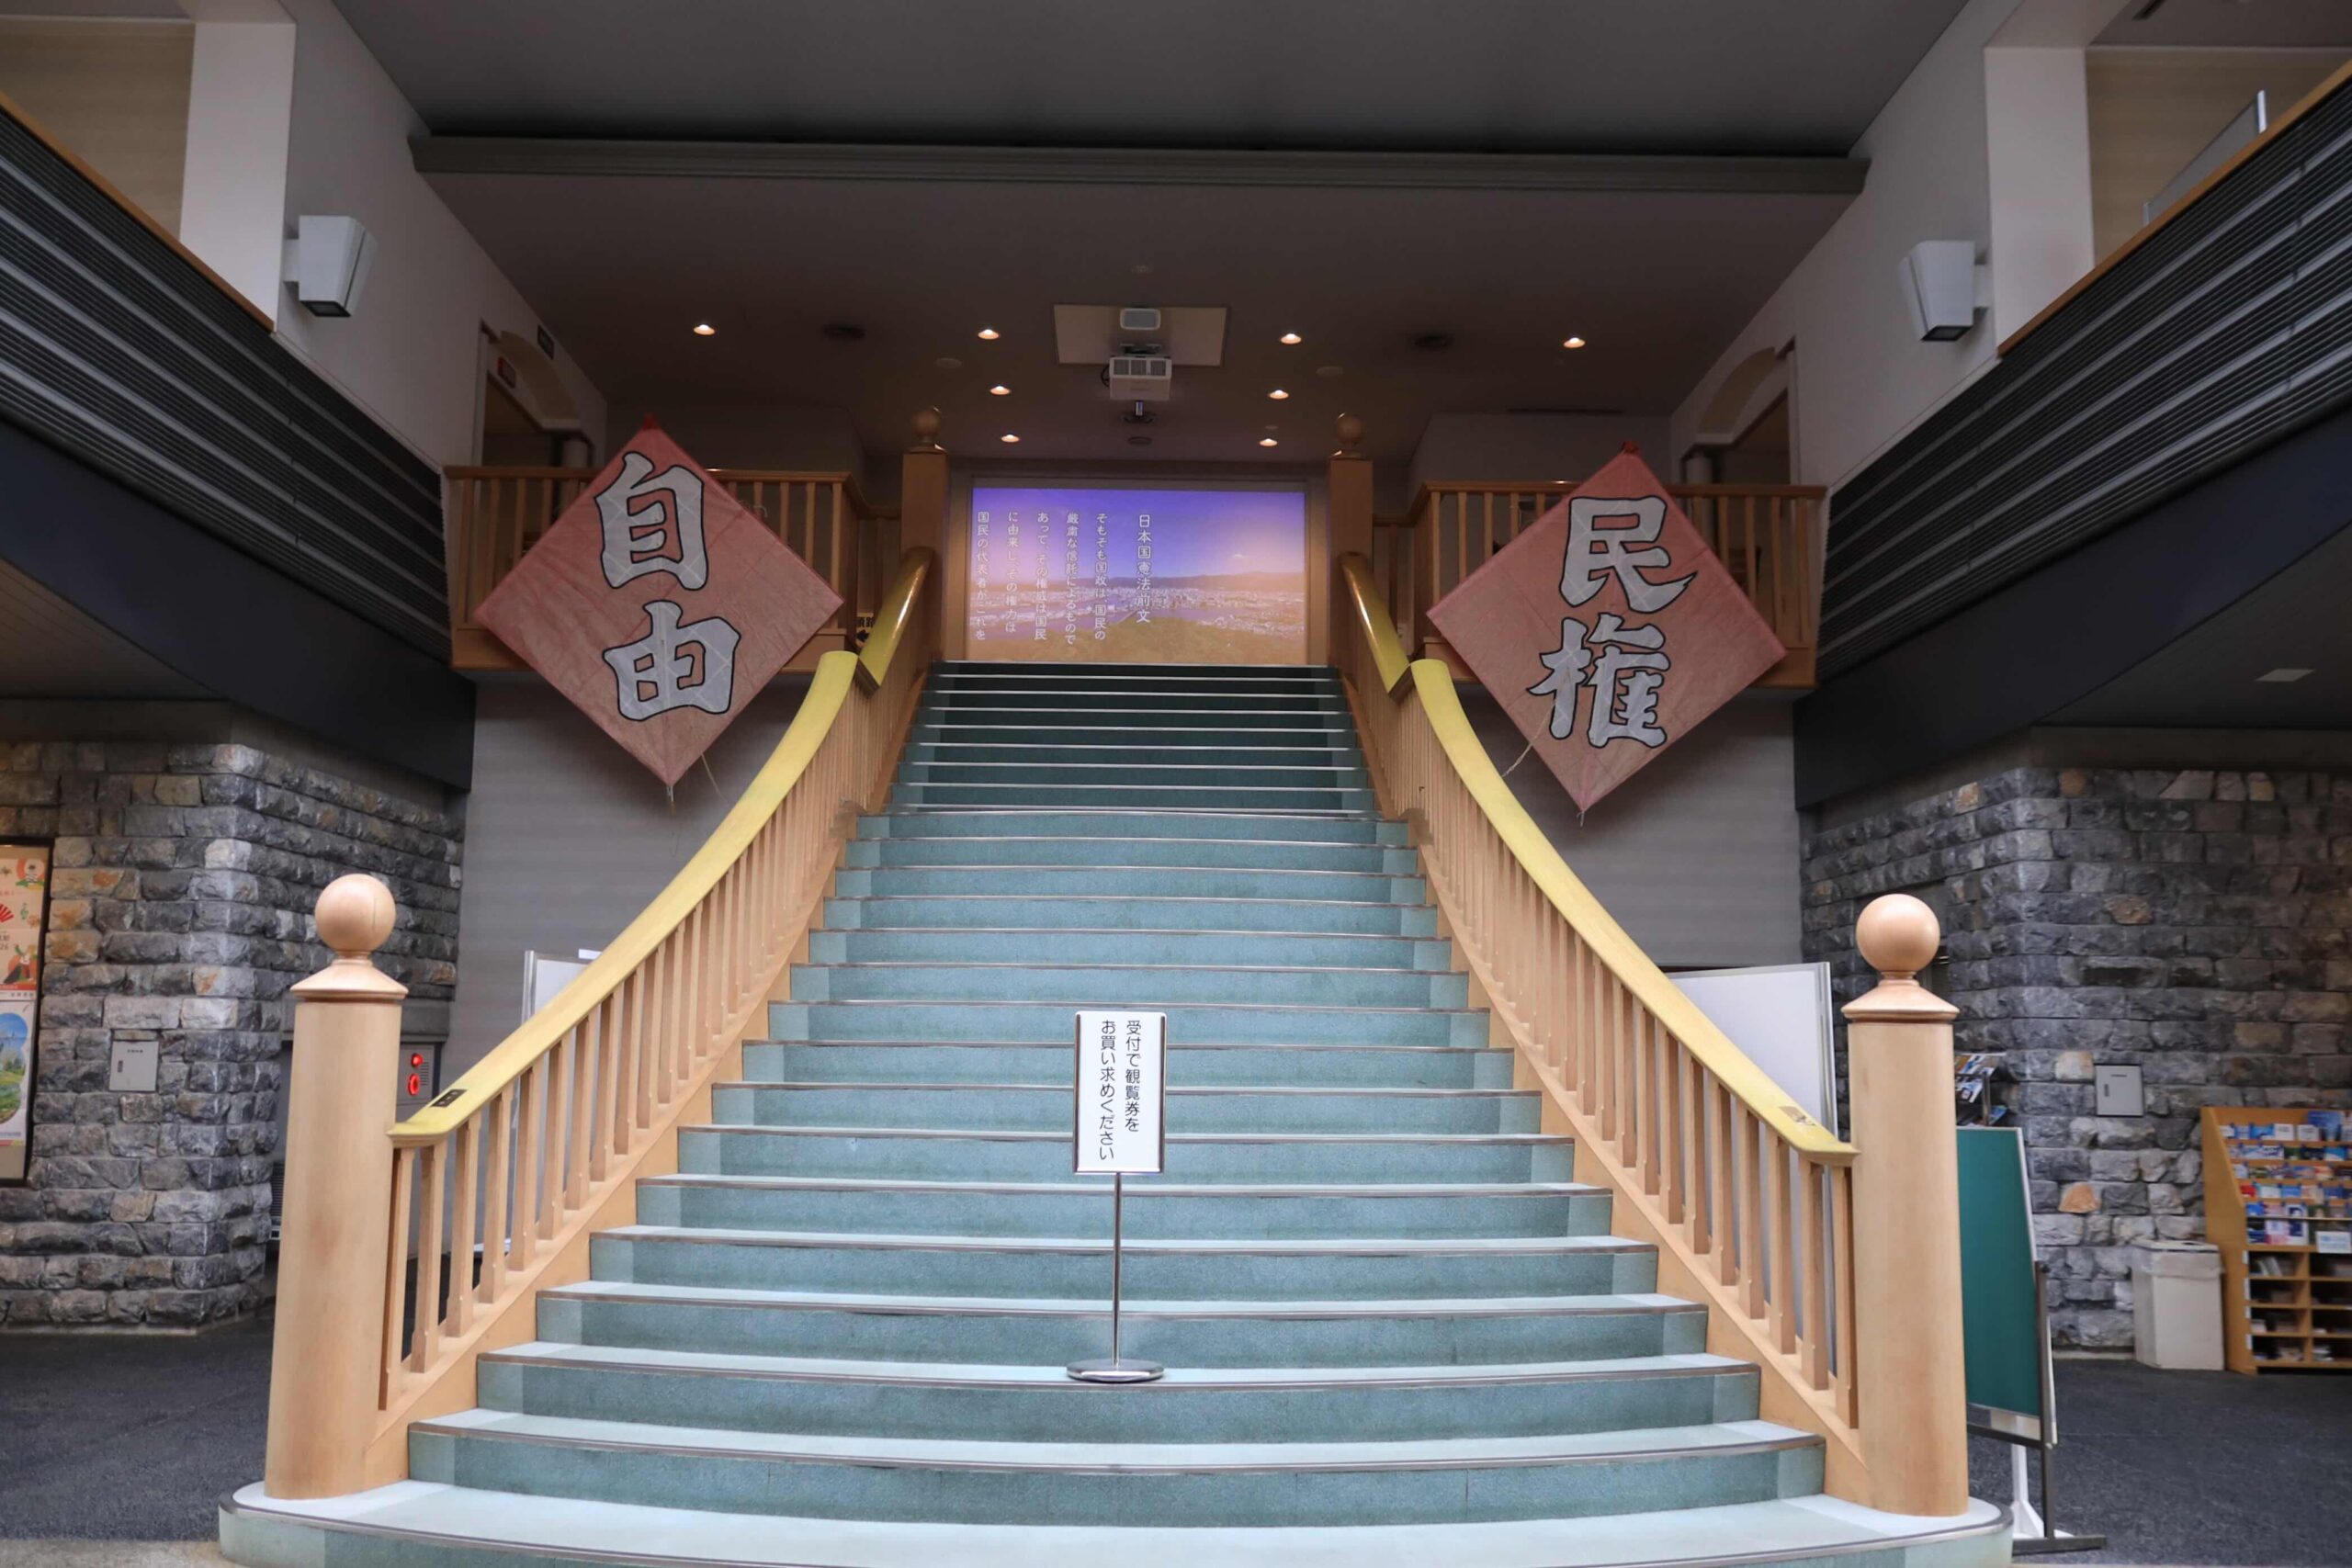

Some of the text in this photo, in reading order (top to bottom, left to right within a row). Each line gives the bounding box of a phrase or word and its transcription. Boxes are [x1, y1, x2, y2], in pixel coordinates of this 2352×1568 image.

[594, 451, 741, 720] 自由
[1136, 514, 1151, 623] 日本国憲法前文
[1525, 496, 1698, 749] 民権
[1100, 1020, 1116, 1160] お買い求めください
[1125, 1020, 1142, 1133] 受付で観覧券を
